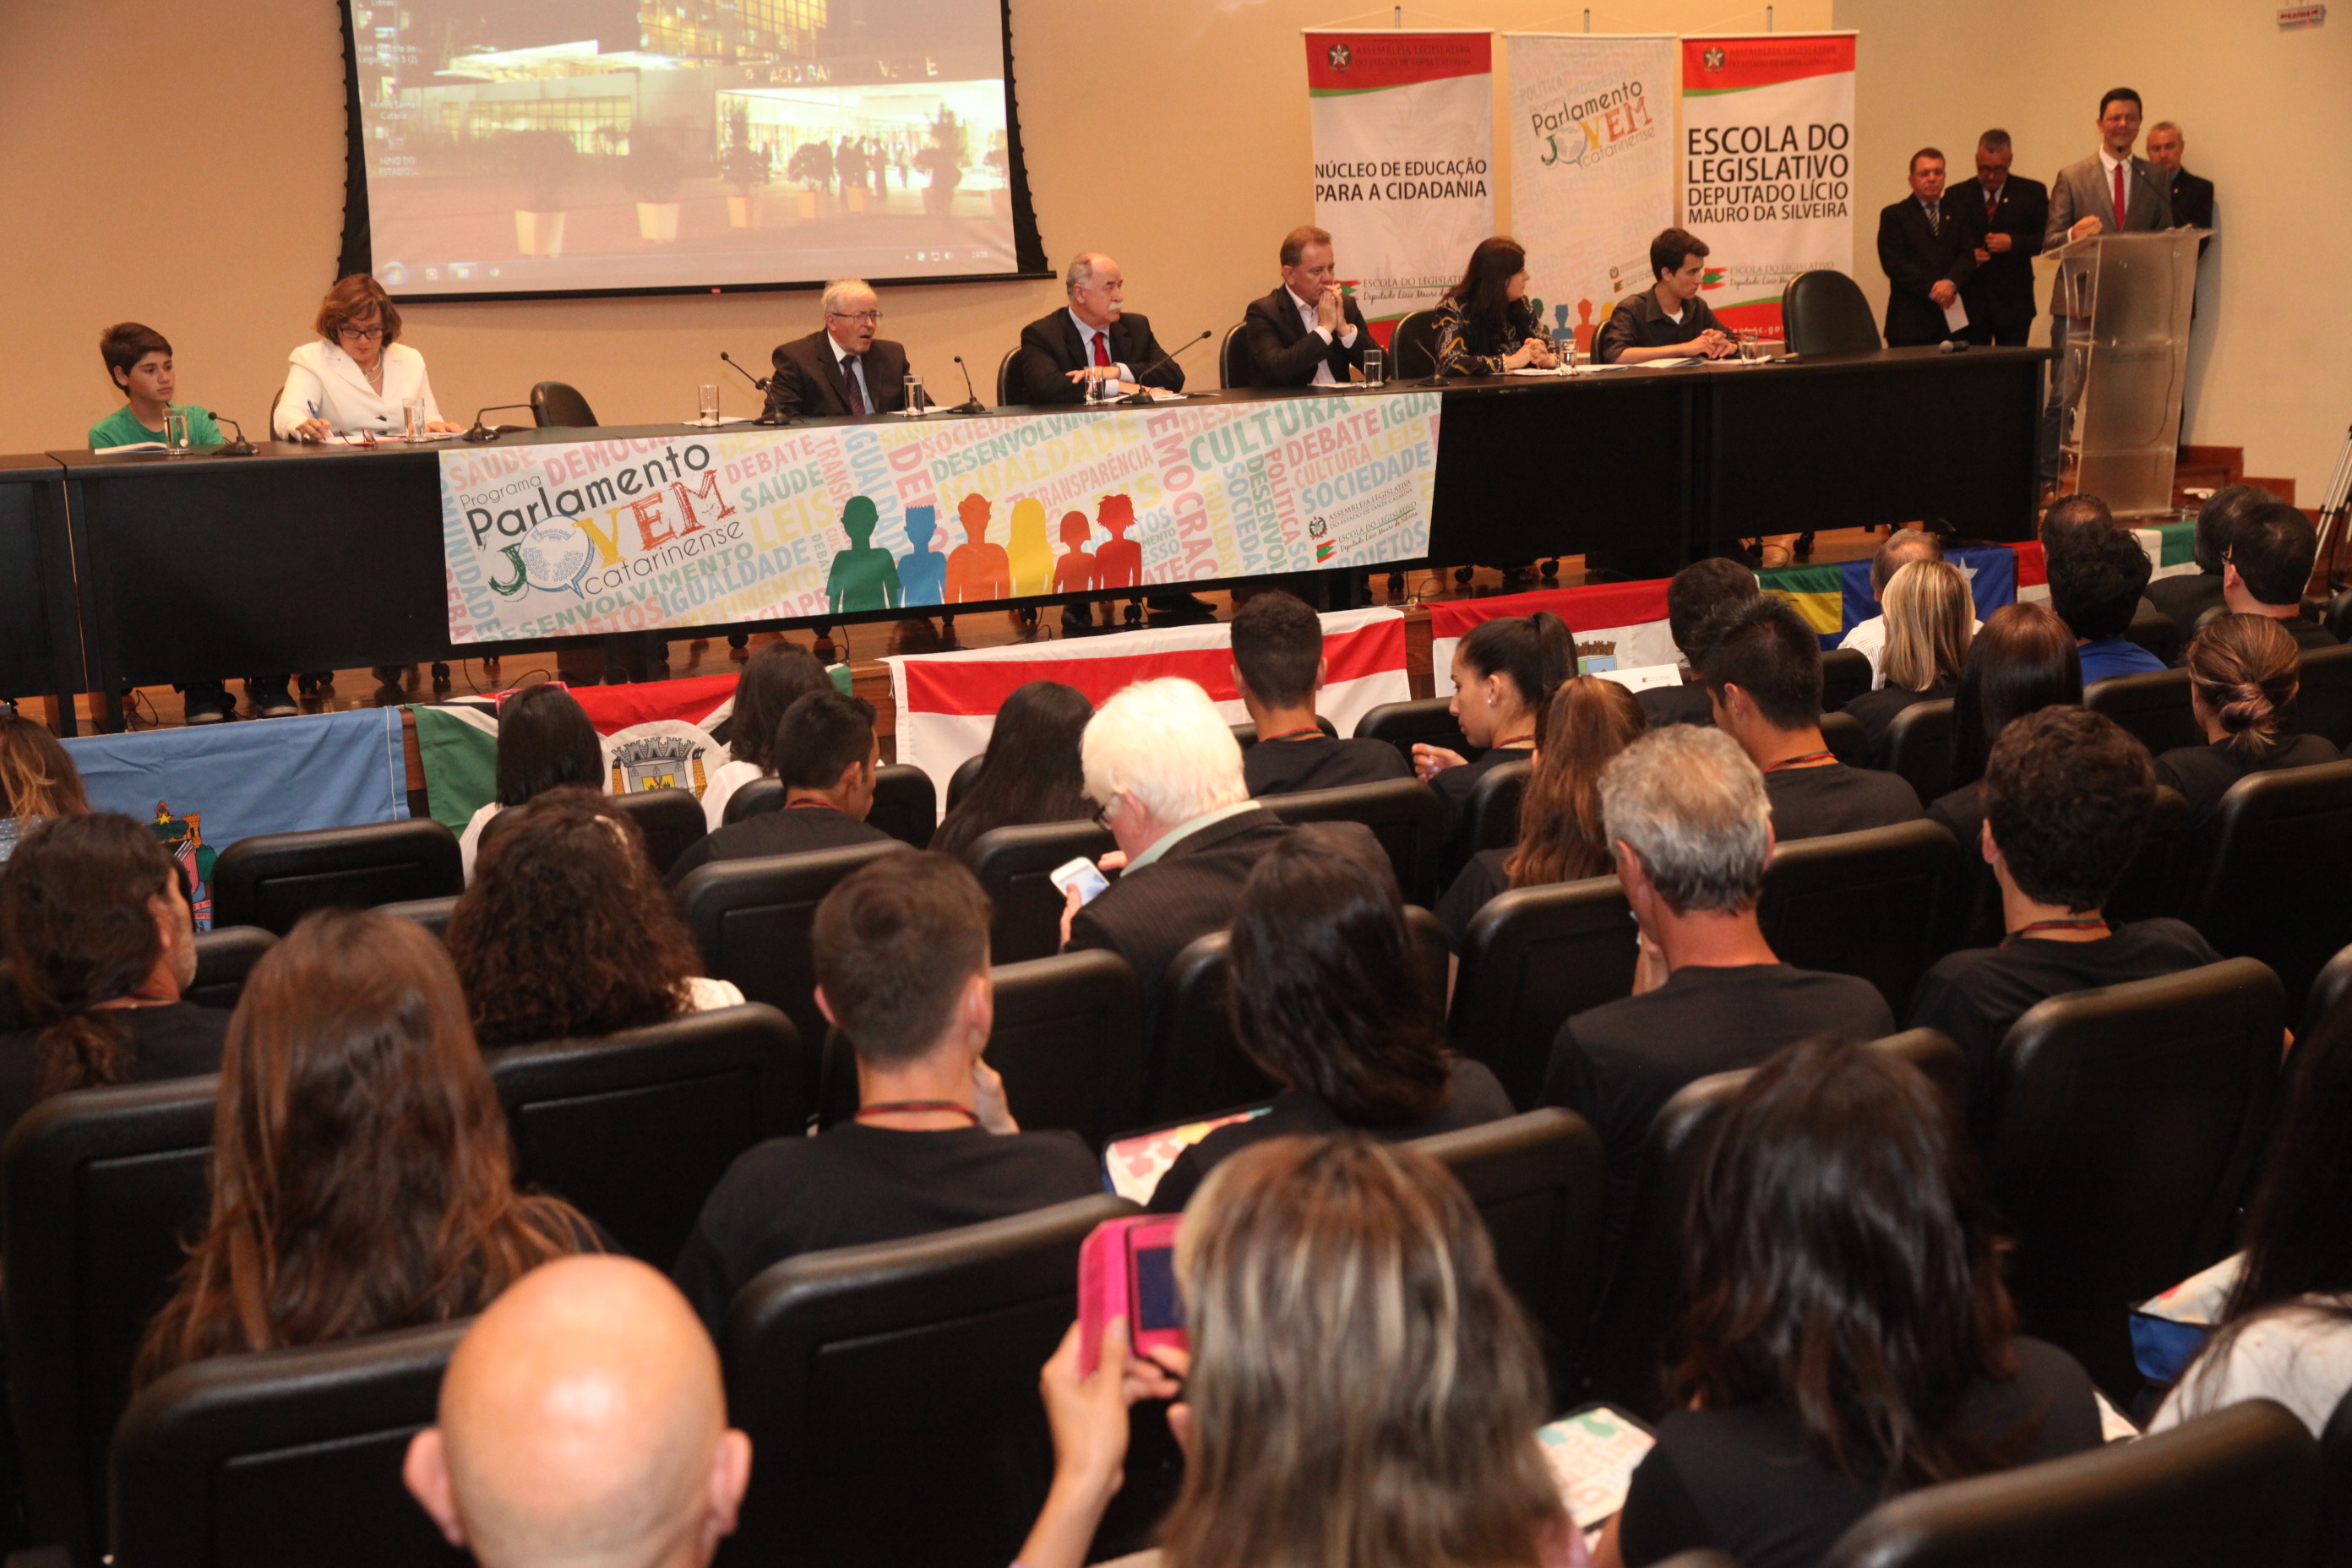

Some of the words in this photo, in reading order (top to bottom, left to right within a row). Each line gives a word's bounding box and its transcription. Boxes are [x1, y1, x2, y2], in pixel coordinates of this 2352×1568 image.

[1532, 81, 1642, 137] Parlamento
[1541, 96, 1652, 169] JOVEM
[1582, 127, 1656, 166] catarinense
[1689, 126, 1799, 155] ESCOLA
[1809, 122, 1849, 151] DO
[1315, 160, 1377, 179] NÚCLEO
[1381, 161, 1401, 177] DE
[1405, 156, 1487, 178] EDUCAÇÃO
[1315, 183, 1364, 203] PARA
[1369, 182, 1380, 201] A
[1386, 180, 1487, 200] CIDADANIA
[1688, 153, 1849, 184] LEGISLATIVO
[1688, 183, 1795, 206] DEPUTADO
[1800, 179, 1848, 202] LÍCIO
[1688, 206, 1749, 224] MAURO
[1754, 204, 1777, 221] DA
[1782, 202, 1848, 220] SILVEIRA
[1364, 278, 1398, 288] ESCOLA
[1401, 277, 1416, 286] DO
[1730, 264, 1763, 275] ESCOLA
[1766, 264, 1781, 273] DO
[1782, 260, 1835, 272] LEGISLATIVO
[724, 433, 816, 486] DEBATE
[1189, 397, 1352, 471] CULTURA
[1286, 408, 1380, 468] DEBATE
[1294, 442, 1373, 489] CULTURA
[1373, 419, 1428, 458] LEIS
[740, 460, 825, 514] SAÚDE
[938, 410, 1141, 514] IGUALDADE
[1029, 444, 1155, 510] TRANSPARÊNCIA
[1302, 441, 1431, 515] SOCIEDADE
[460, 476, 542, 510] Programa
[466, 444, 710, 547] Parlamento
[1264, 447, 1302, 546] POLÍTICA
[1328, 498, 1370, 521] ASSEMBLEIA
[1372, 479, 1412, 504] LEGISLATIVA
[1330, 521, 1340, 530] DO
[1340, 512, 1363, 527] ESTADO
[1371, 501, 1388, 514] SANTA
[1388, 487, 1413, 504] CATARINA
[487, 468, 737, 602] JOVEM
[749, 490, 836, 553] LEIS
[1338, 527, 1364, 543] ESCOLA
[1365, 520, 1376, 531] DO
[1377, 501, 1417, 526] LEGISLATIVO
[585, 520, 744, 595] catarinense
[658, 537, 812, 618] IGUALDADE
